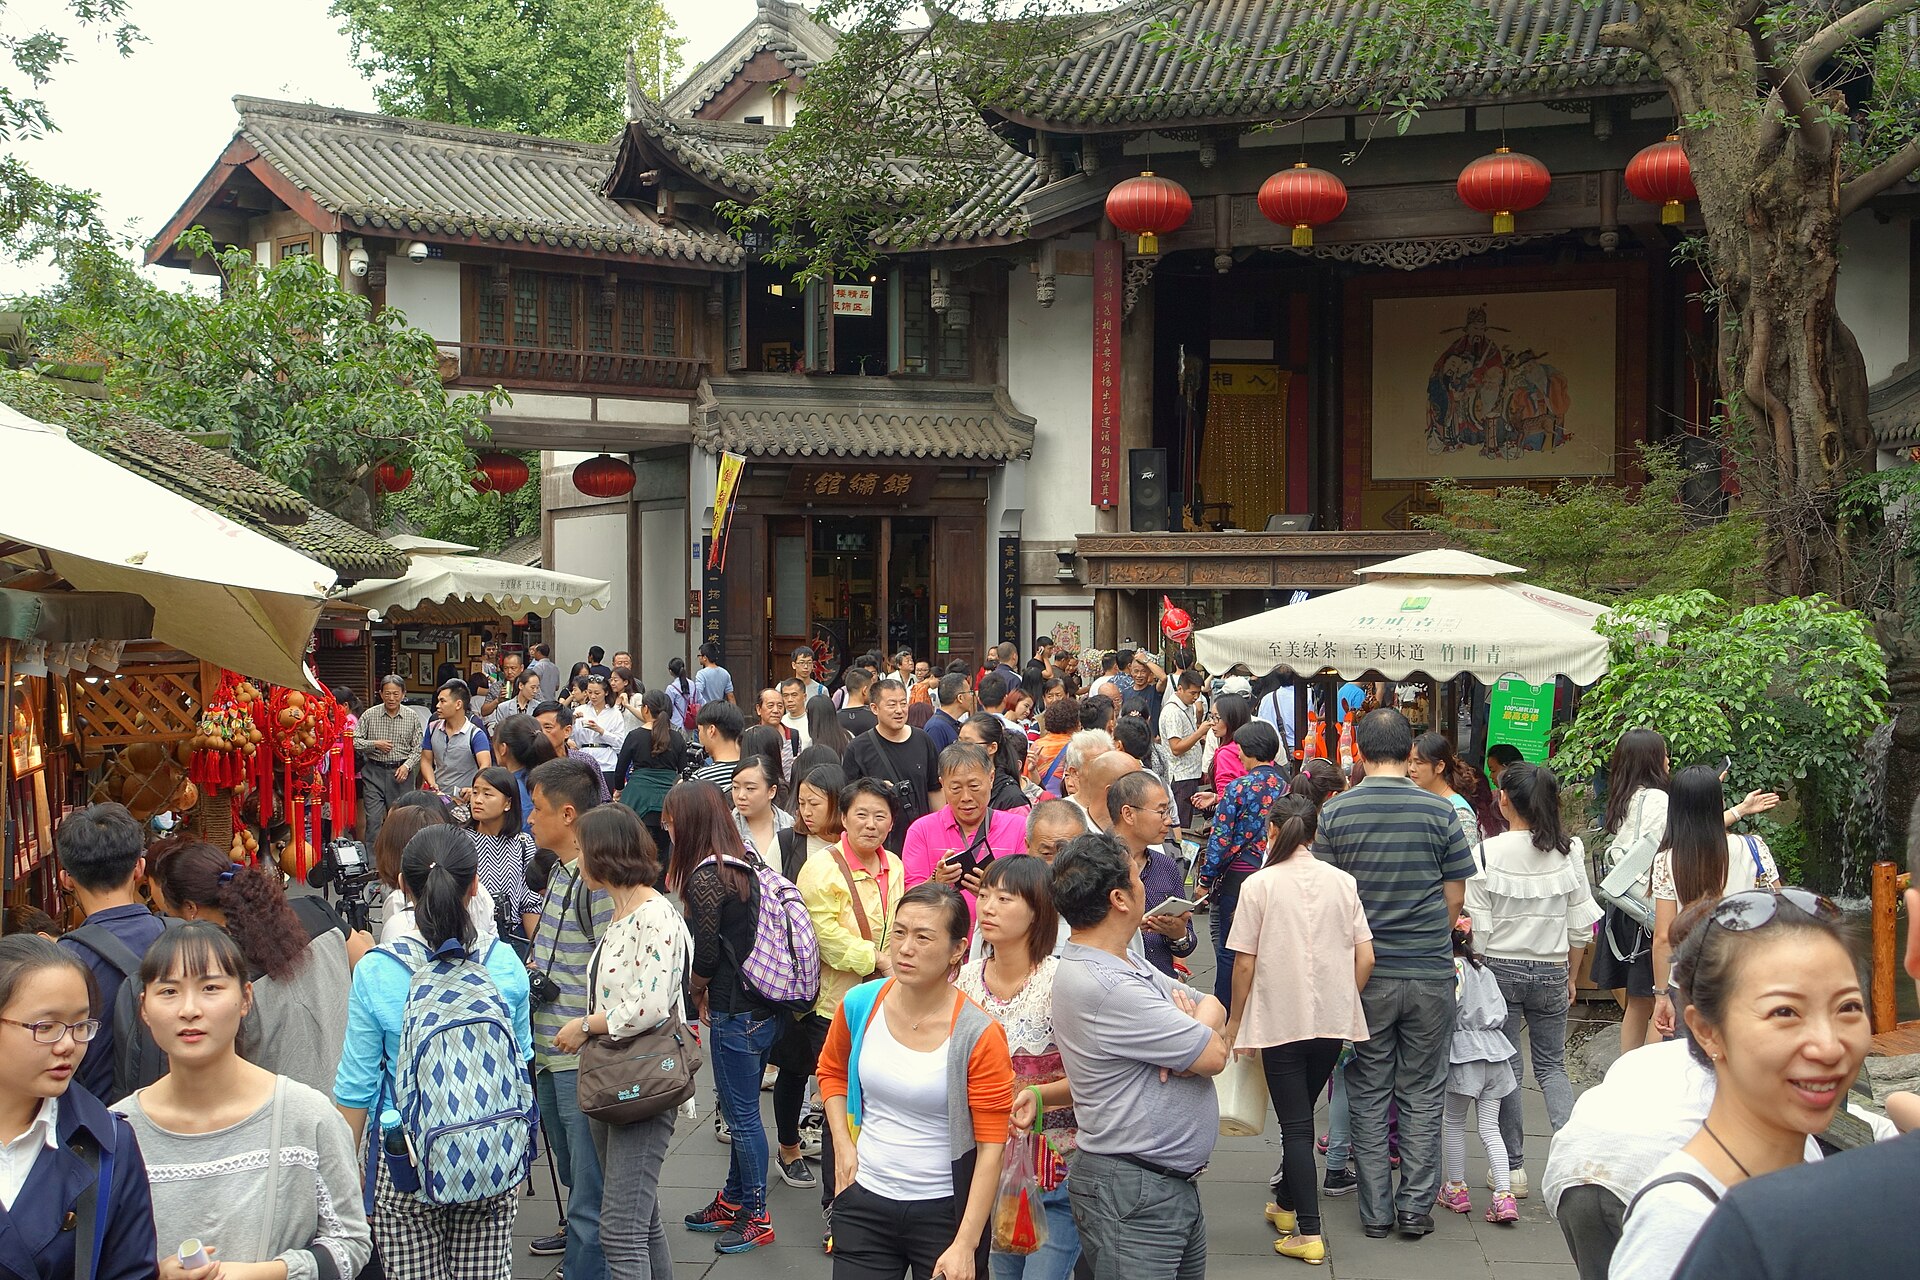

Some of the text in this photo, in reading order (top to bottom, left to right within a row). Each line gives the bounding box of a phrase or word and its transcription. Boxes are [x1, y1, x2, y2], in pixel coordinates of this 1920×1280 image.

[1268, 641, 1338, 659] 至美绿茶
[1354, 643, 1425, 661] 至美味道
[1440, 643, 1502, 665] 竹叶青
